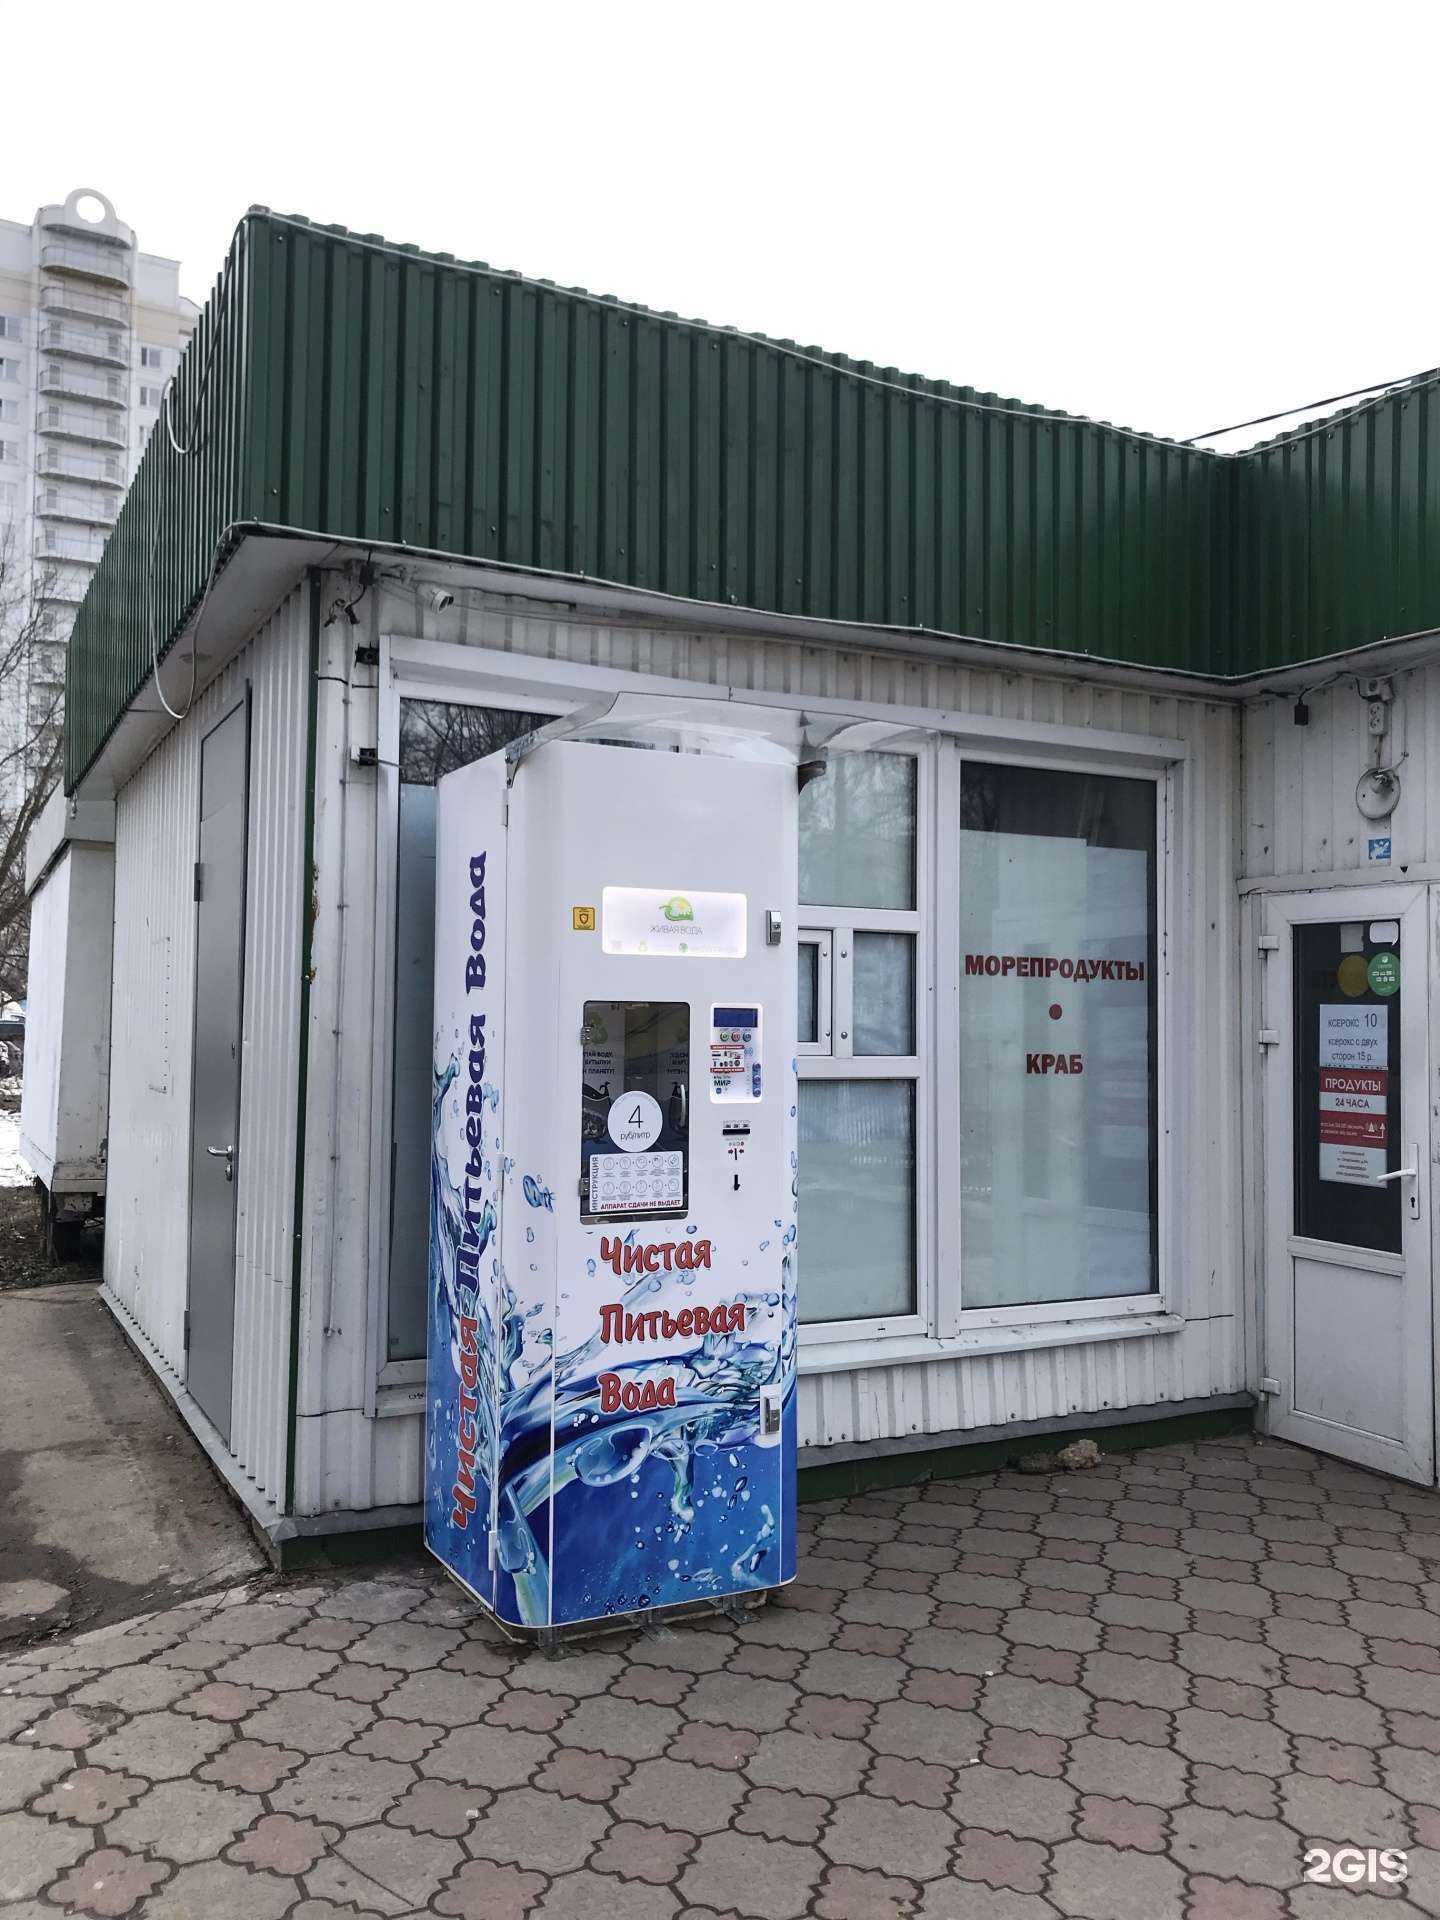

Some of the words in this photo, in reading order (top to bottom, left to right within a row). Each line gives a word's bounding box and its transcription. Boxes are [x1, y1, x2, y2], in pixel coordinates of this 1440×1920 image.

[466, 851, 487, 995] Вода
[965, 955, 1144, 982] МОРЕПРОДУКТЫ
[1328, 1018, 1359, 1028] КСЕРОКС
[1364, 1013, 1378, 1028] 10
[1361, 1039, 1378, 1048] двух
[1026, 1053, 1083, 1075] КРАБ
[1331, 1053, 1355, 1062] сторон
[714, 1079, 731, 1087] МИР
[1325, 1078, 1381, 1091] ПРОДУКТЫ
[1335, 1098, 1345, 1107] 24
[1346, 1098, 1370, 1108] ЧАСА
[628, 1104, 644, 1129] 4
[456, 1014, 486, 1293] Питьевая
[591, 1156, 600, 1211] ИНСТРУКЦИЯ
[628, 1201, 649, 1209] СДАЧИ
[600, 1236, 712, 1276] Чистая
[599, 1303, 746, 1344] Питьевая
[598, 1372, 677, 1413] Вода
[451, 1315, 479, 1530] Чистая
